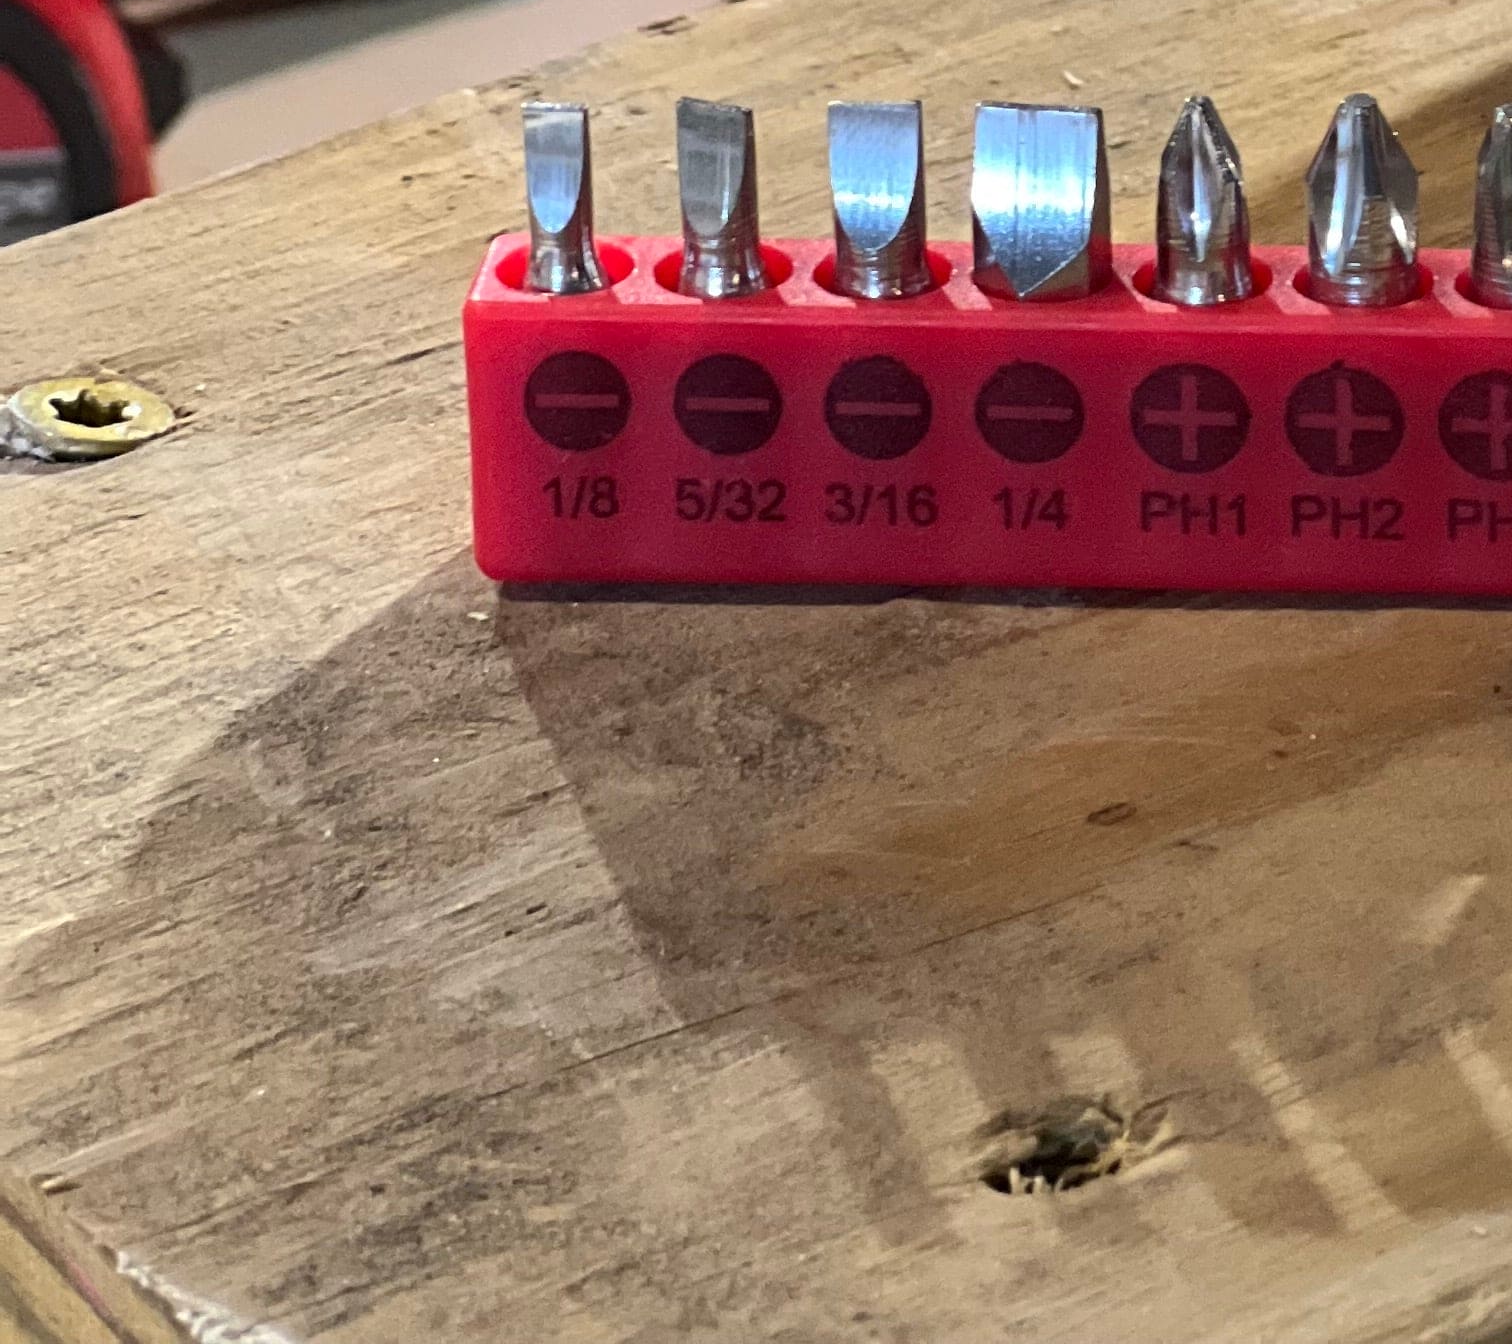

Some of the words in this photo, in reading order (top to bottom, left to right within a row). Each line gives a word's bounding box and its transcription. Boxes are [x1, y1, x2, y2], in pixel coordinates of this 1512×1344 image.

[542, 476, 620, 520] 1/8
[675, 478, 789, 525] 5/32
[825, 481, 938, 528] 3/16
[992, 488, 1066, 531] 1/4
[1139, 491, 1249, 536] PH1
[1290, 496, 1405, 541] PH2
